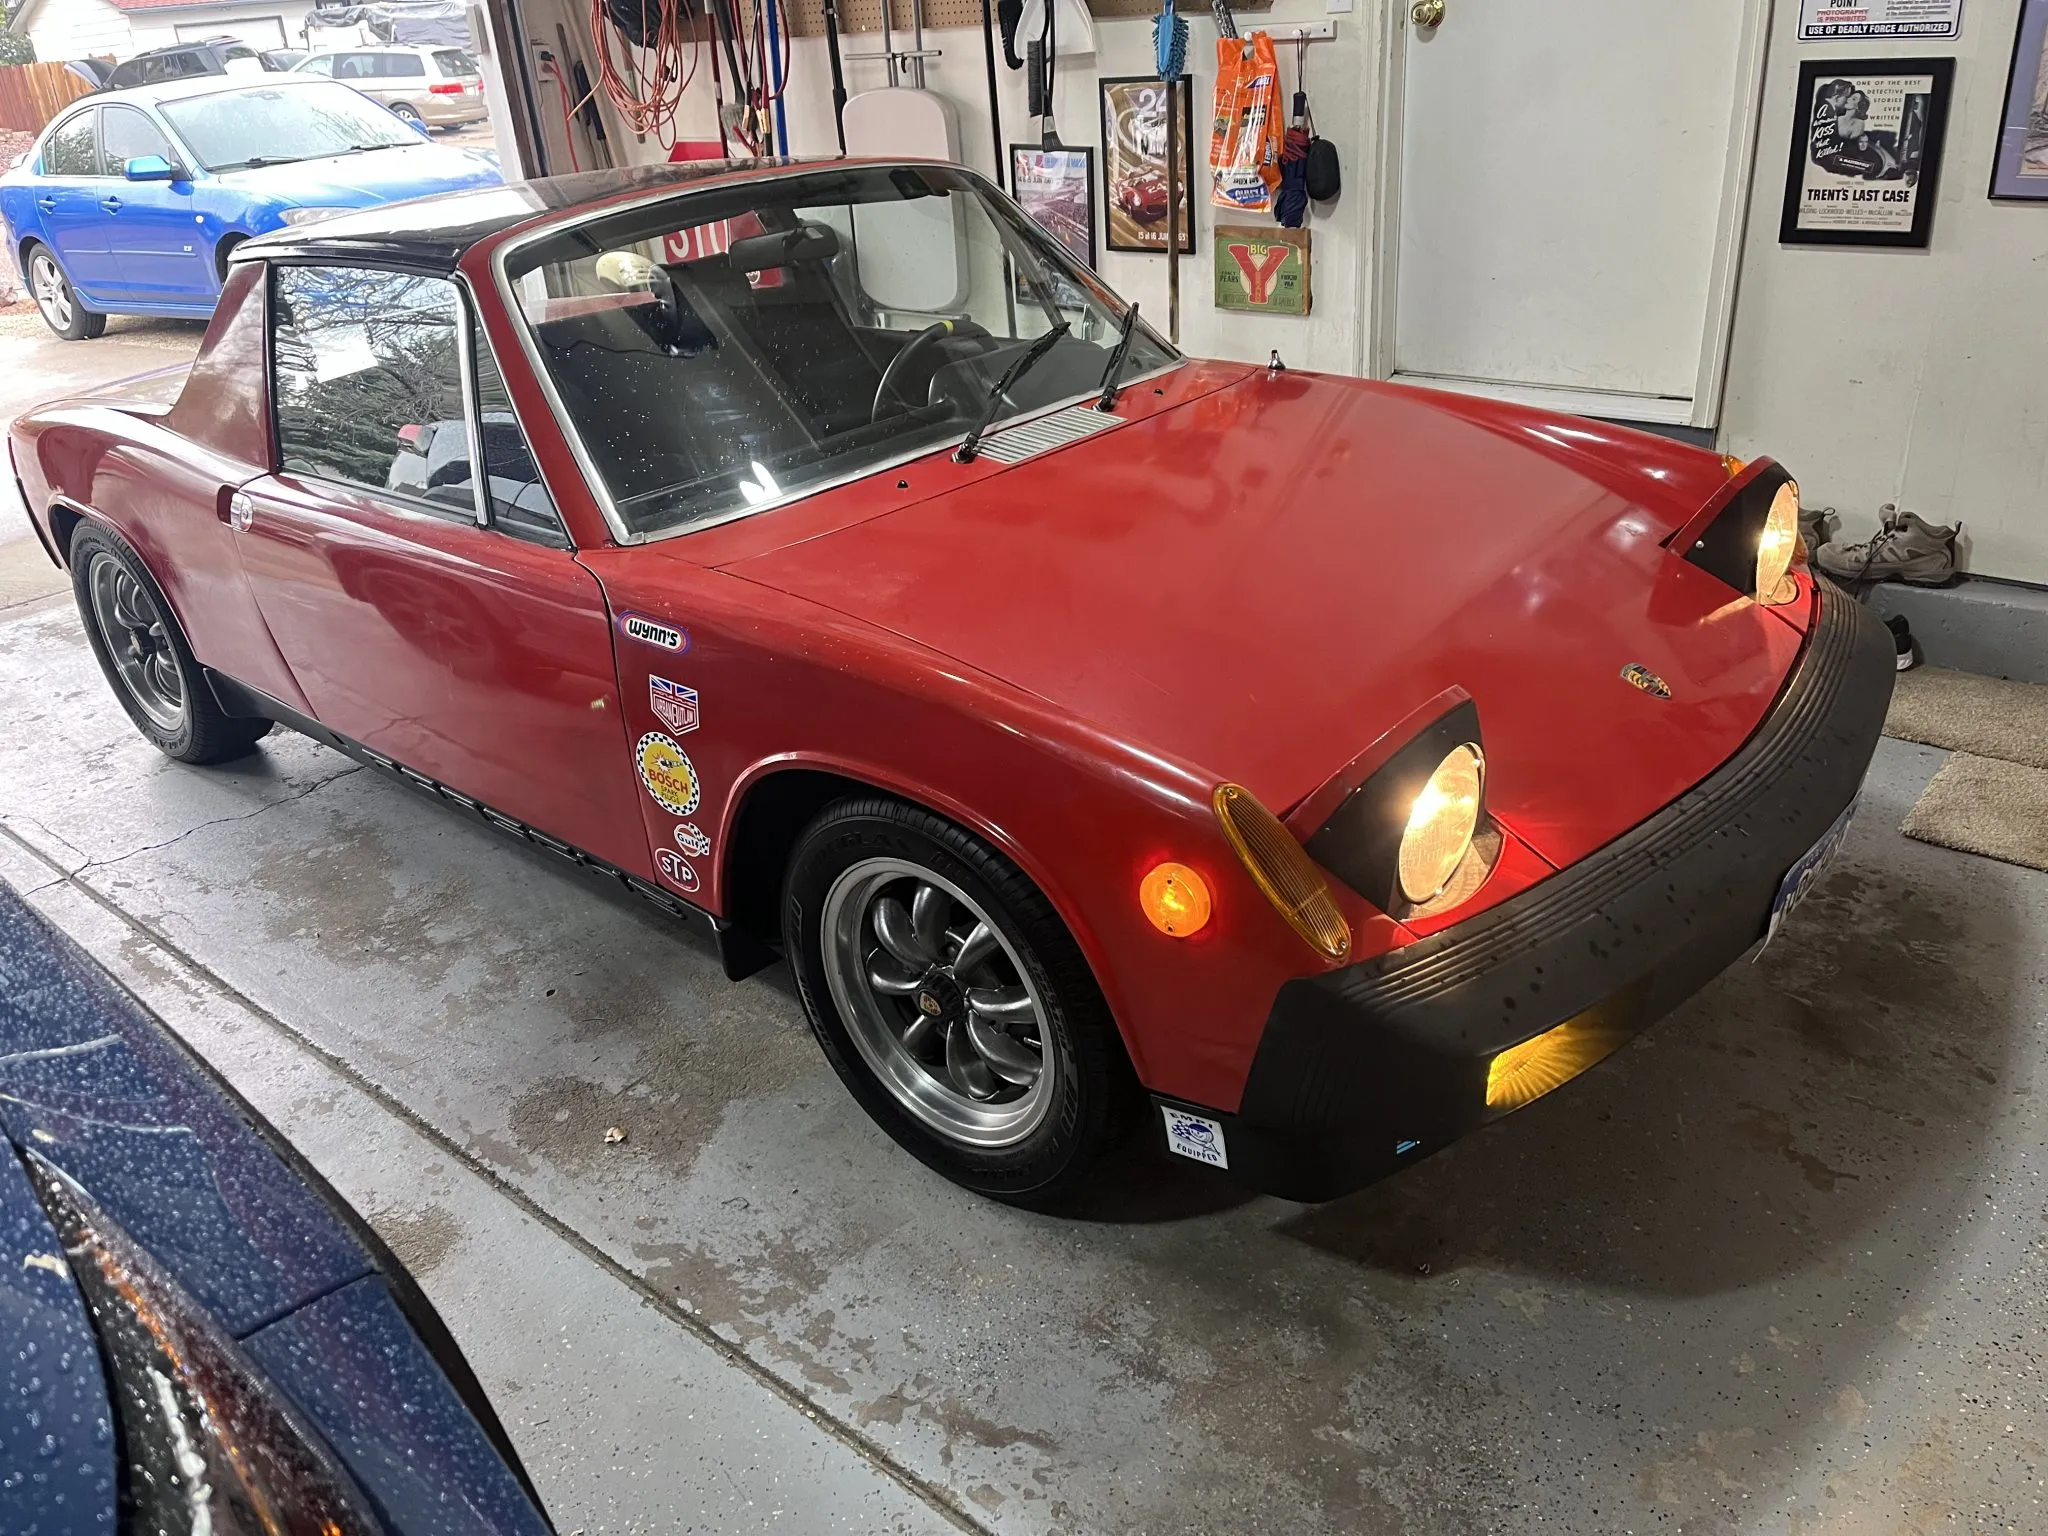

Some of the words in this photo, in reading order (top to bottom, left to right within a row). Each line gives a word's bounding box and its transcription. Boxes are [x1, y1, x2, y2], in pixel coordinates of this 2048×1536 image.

[1808, 26, 1824, 34] USE
[1825, 25, 1836, 34] OF
[1838, 25, 1868, 34] DEADLY
[1869, 24, 1896, 33] FORCE
[1898, 23, 1949, 33] AUTHORIZED
[1807, 188, 1849, 201] TRENT'S
[1852, 190, 1880, 202] LAST
[1882, 190, 1910, 203] CASE
[1250, 244, 1267, 254] BIG
[1228, 244, 1289, 304] Y
[648, 768, 689, 795] BOSCH
[677, 832, 700, 849] Gulf
[661, 854, 693, 881] STP
[1176, 1143, 1218, 1161] EQUIPPED
